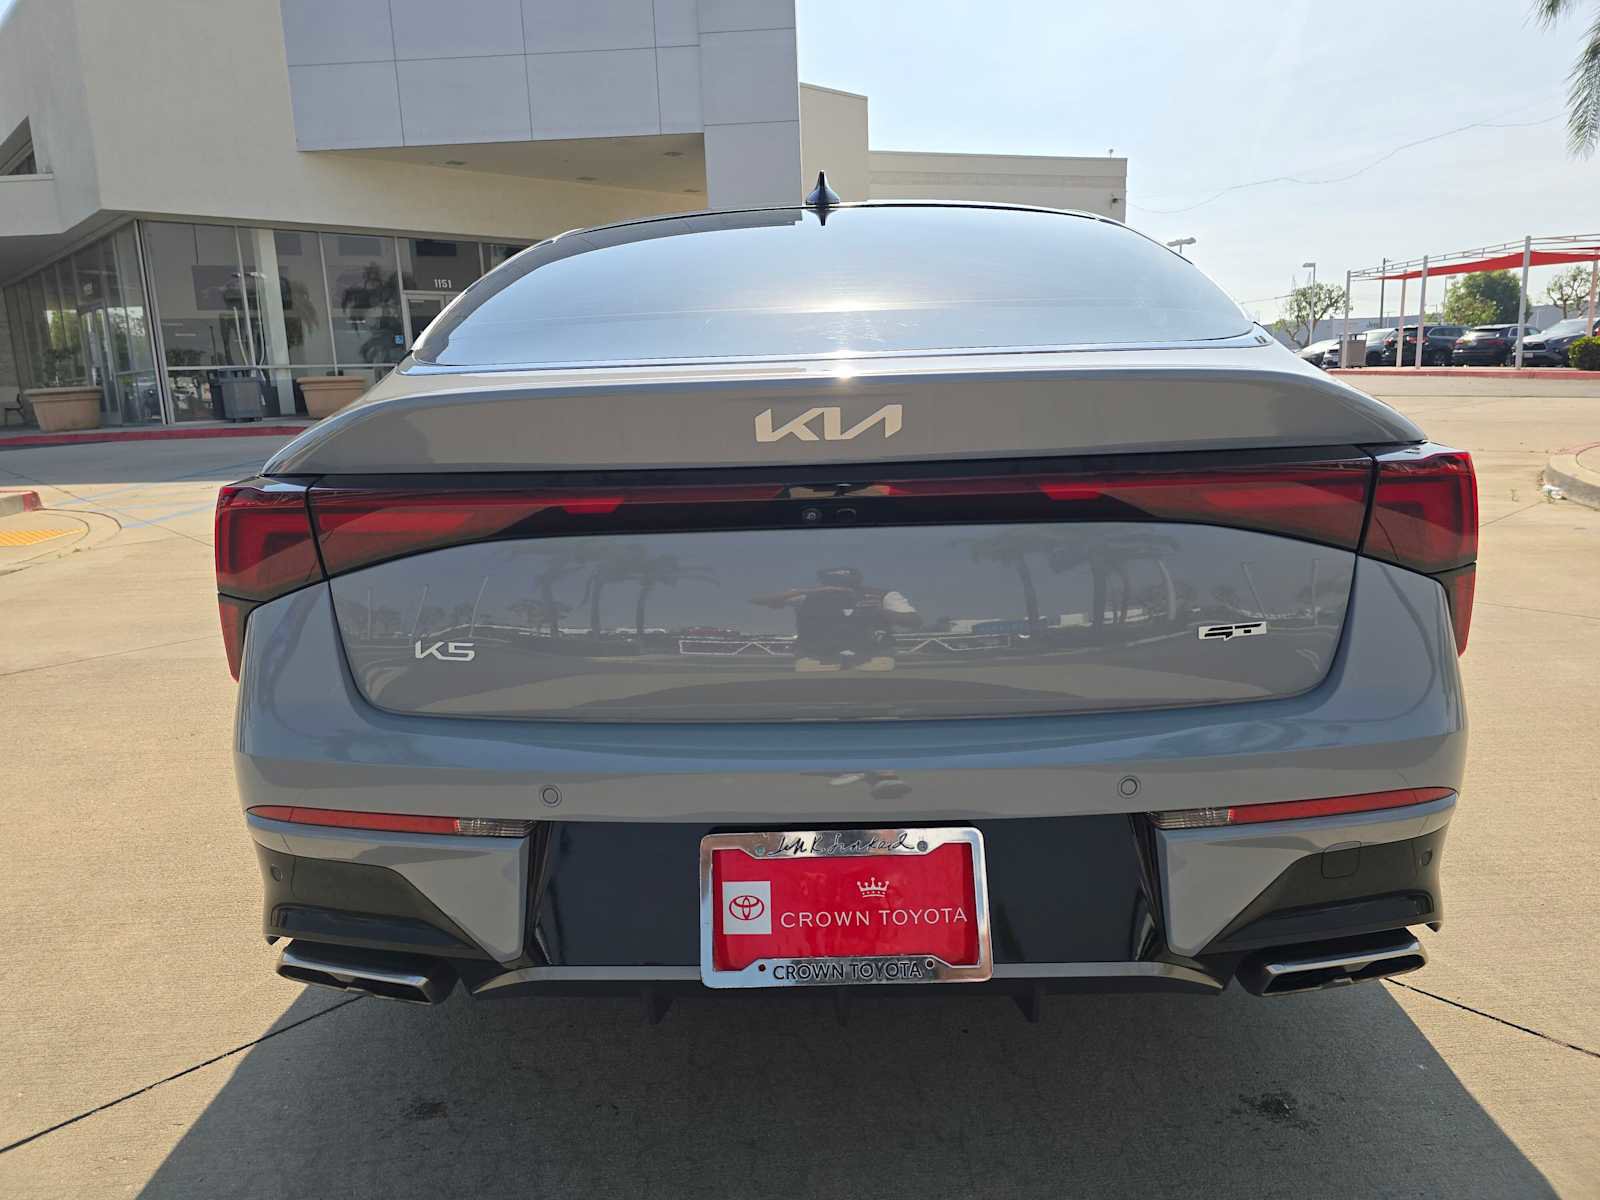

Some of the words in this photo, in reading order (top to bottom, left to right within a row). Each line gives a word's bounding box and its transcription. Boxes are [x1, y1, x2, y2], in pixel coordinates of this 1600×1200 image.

[434, 279, 452, 289] 1151
[415, 640, 475, 661] K5
[780, 910, 870, 928] CROWN
[878, 907, 968, 926] TOYOTA
[773, 962, 845, 980] CROWN
[849, 959, 923, 979] TOYOTA
